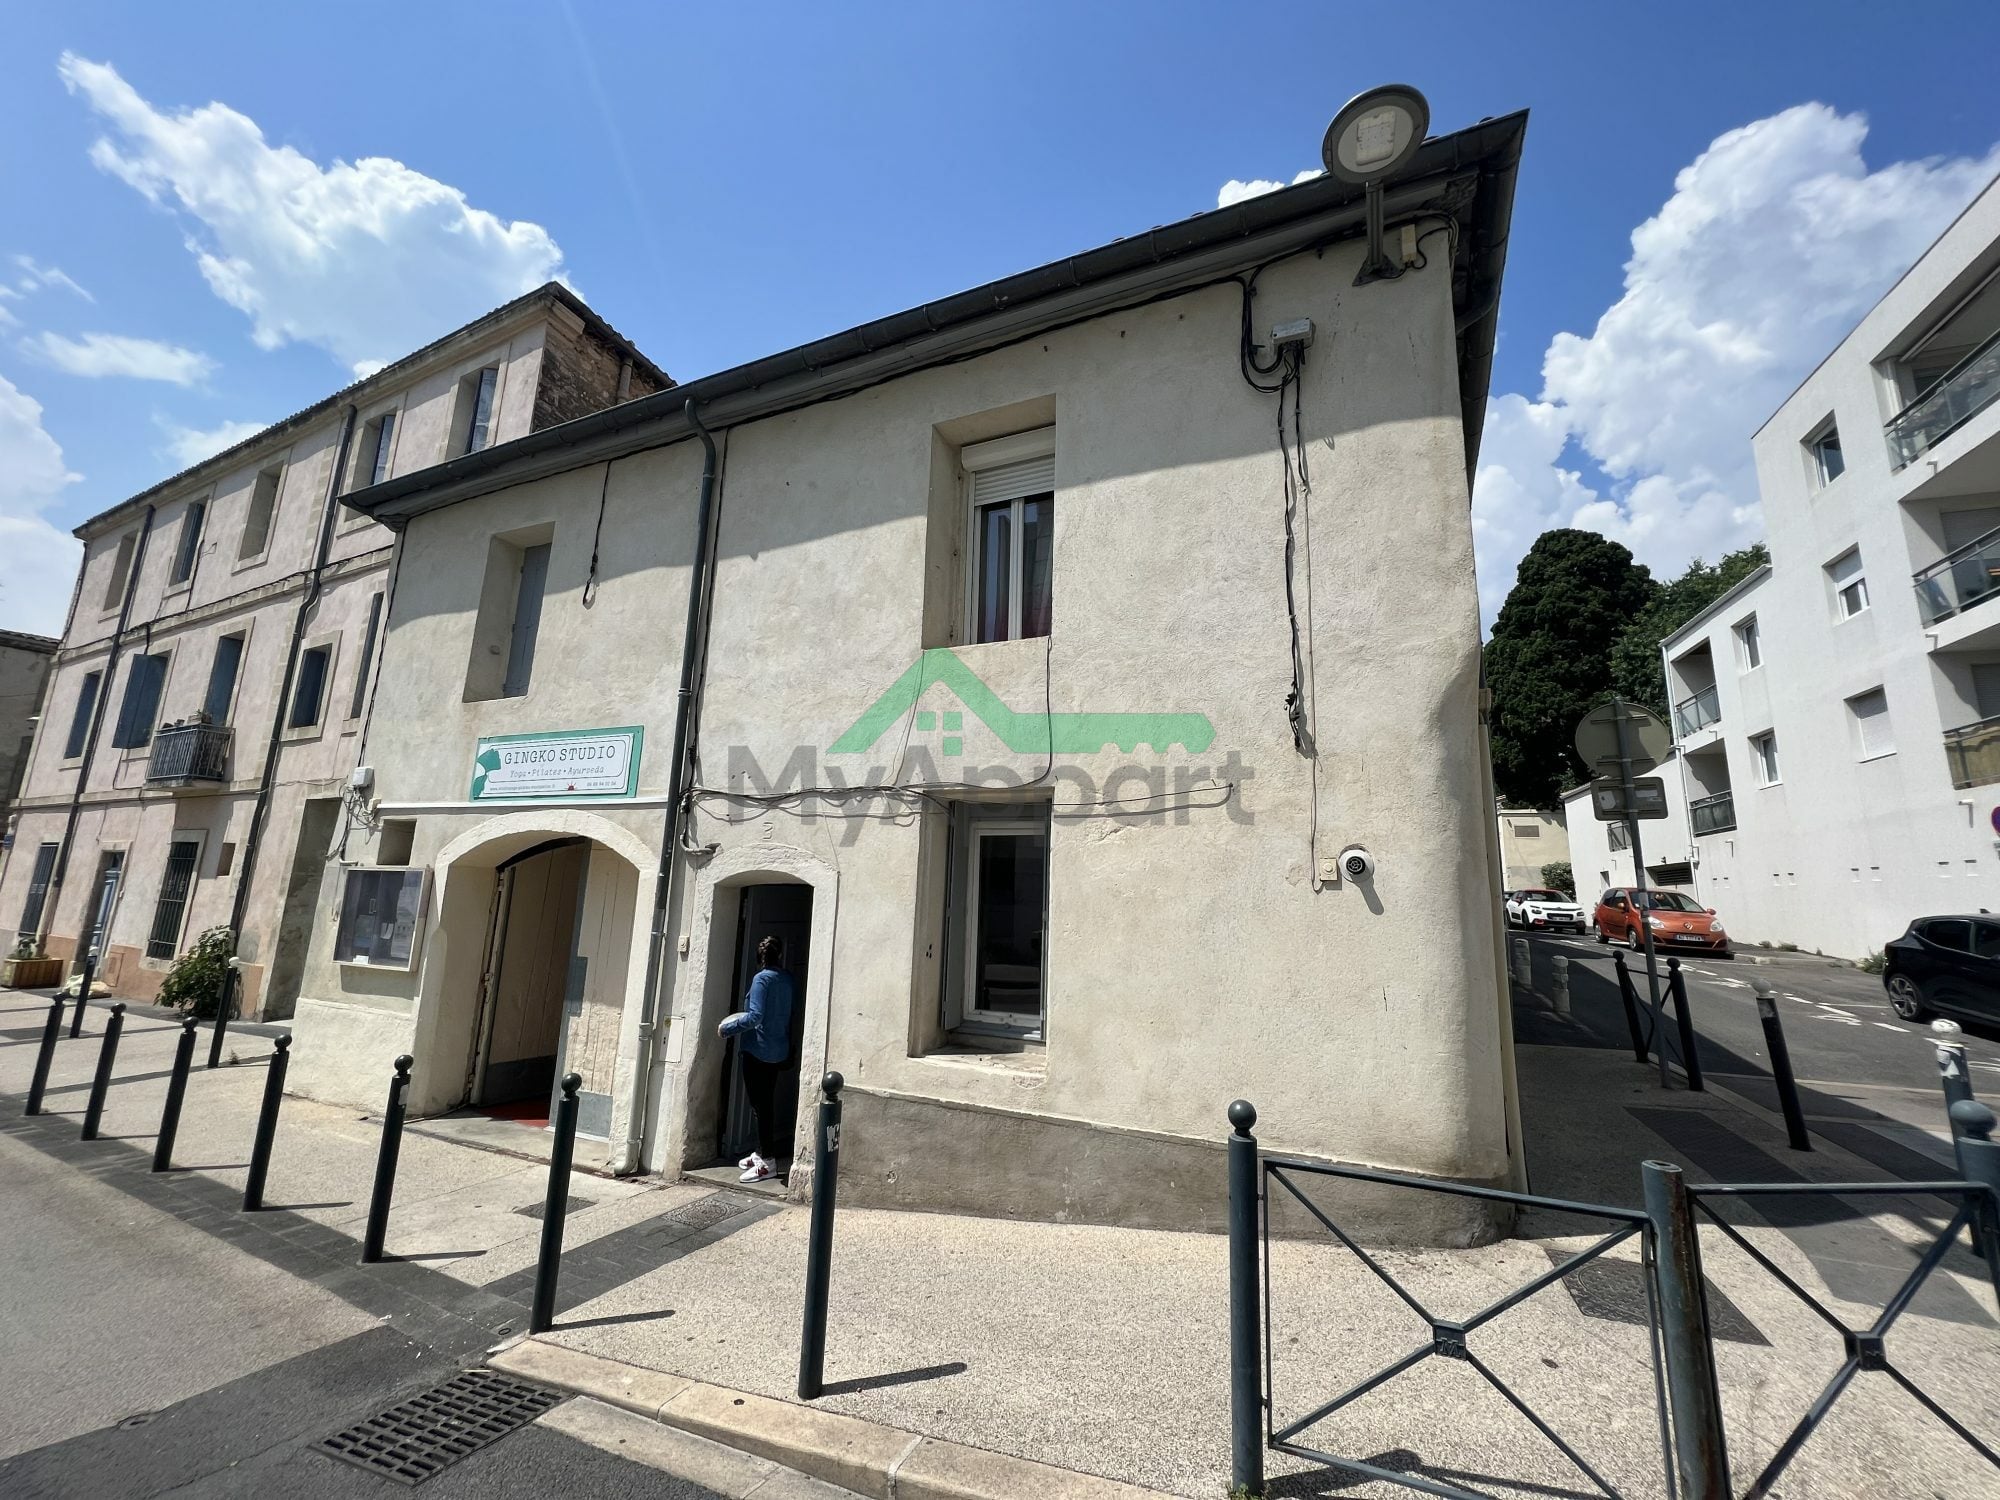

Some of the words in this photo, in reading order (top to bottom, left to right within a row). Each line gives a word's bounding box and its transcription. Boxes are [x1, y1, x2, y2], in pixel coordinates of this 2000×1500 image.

[504, 750, 556, 765] GINGKO
[559, 746, 616, 761] STUDIO
[531, 767, 561, 777] Pilates
[567, 765, 605, 776] Ayurveda
